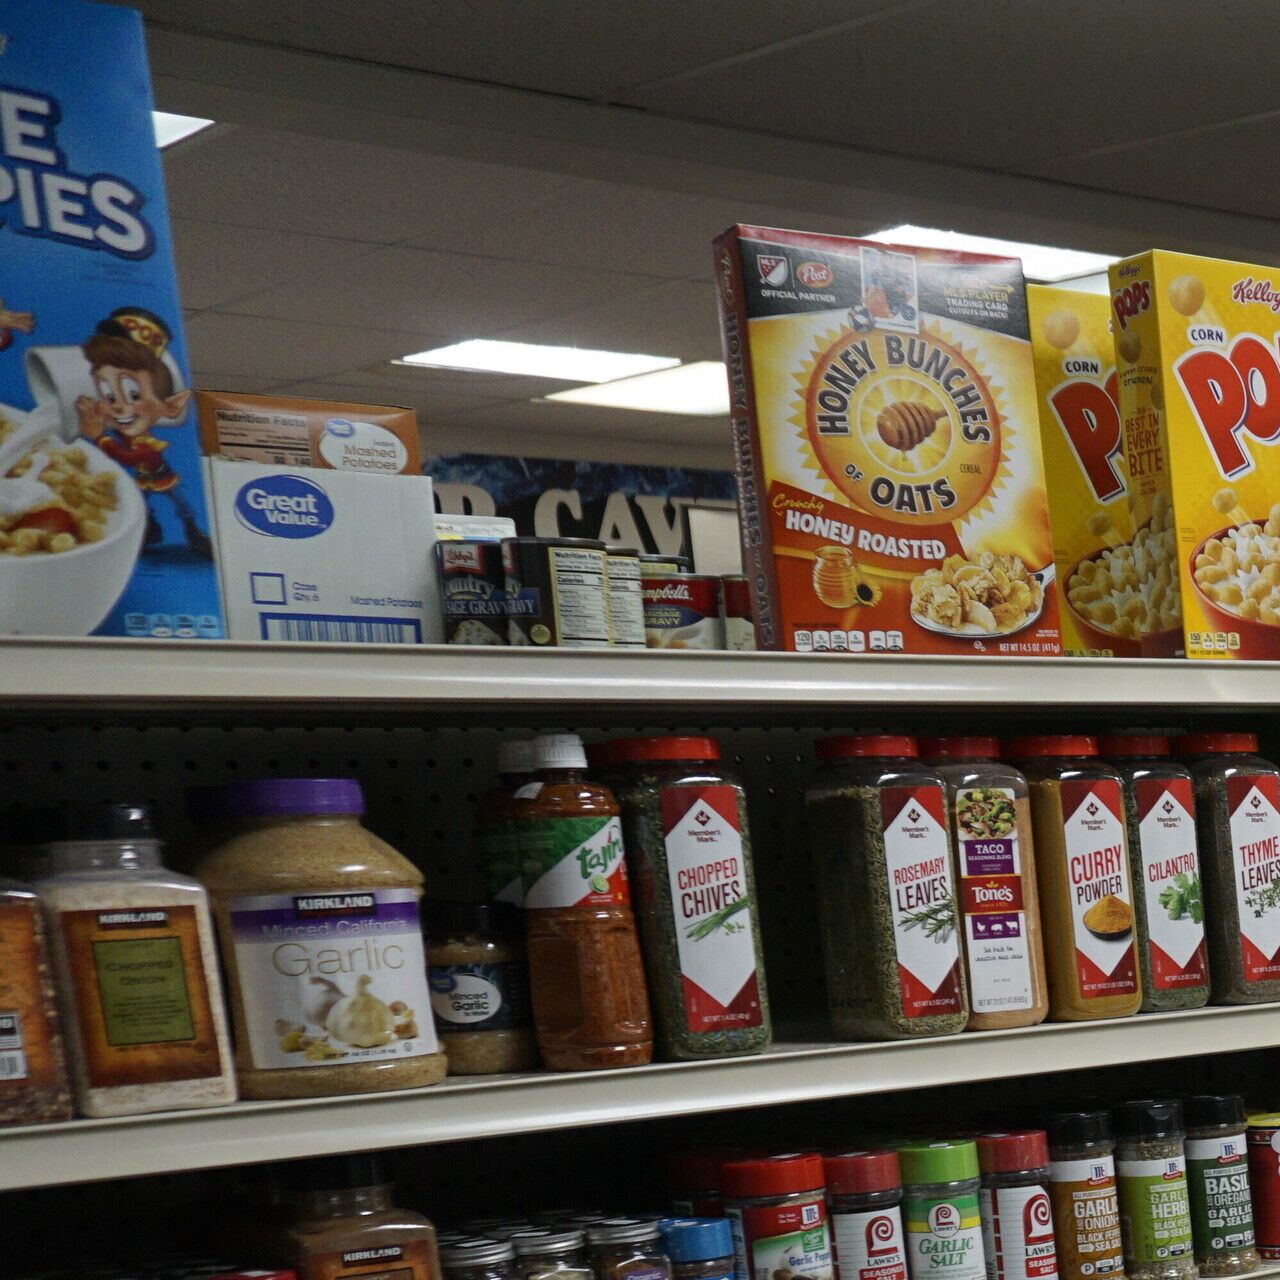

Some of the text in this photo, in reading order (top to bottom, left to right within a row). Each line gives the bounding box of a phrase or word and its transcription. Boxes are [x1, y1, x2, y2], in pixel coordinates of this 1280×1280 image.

[761, 289, 836, 303] OFFICIAL PARTNER
[946, 298, 1008, 311] TRADING CARD
[1190, 329, 1224, 343] CORN
[817, 334, 992, 444] HONEY BUNCHES
[1125, 414, 1160, 433] BEST IN
[1128, 430, 1160, 450] EVERY
[343, 446, 397, 459] Mashed
[1129, 450, 1163, 476] BITE
[342, 458, 397, 471] Potatoes
[844, 462, 865, 484] OF
[247, 491, 319, 513] Great
[869, 475, 956, 516] OATS
[265, 509, 319, 526] Value
[785, 511, 948, 561] HONEY ROASTED
[974, 843, 1005, 854] TACO
[677, 857, 738, 890] CHOPPED
[894, 856, 945, 884] ROSEMARY
[1070, 843, 1124, 885] CURRY
[1148, 853, 1196, 884] CILANTRO
[680, 882, 741, 919] CHIVES
[896, 877, 948, 911] LEAVES
[970, 882, 1014, 904] Tone's
[1076, 875, 1124, 906] POWDER
[297, 894, 374, 912] KIRKLAND
[272, 940, 405, 978] Garlic
[343, 1247, 401, 1263] KIRKLAND
[918, 1236, 973, 1255] GARLIC
[930, 1252, 965, 1270] SALT
